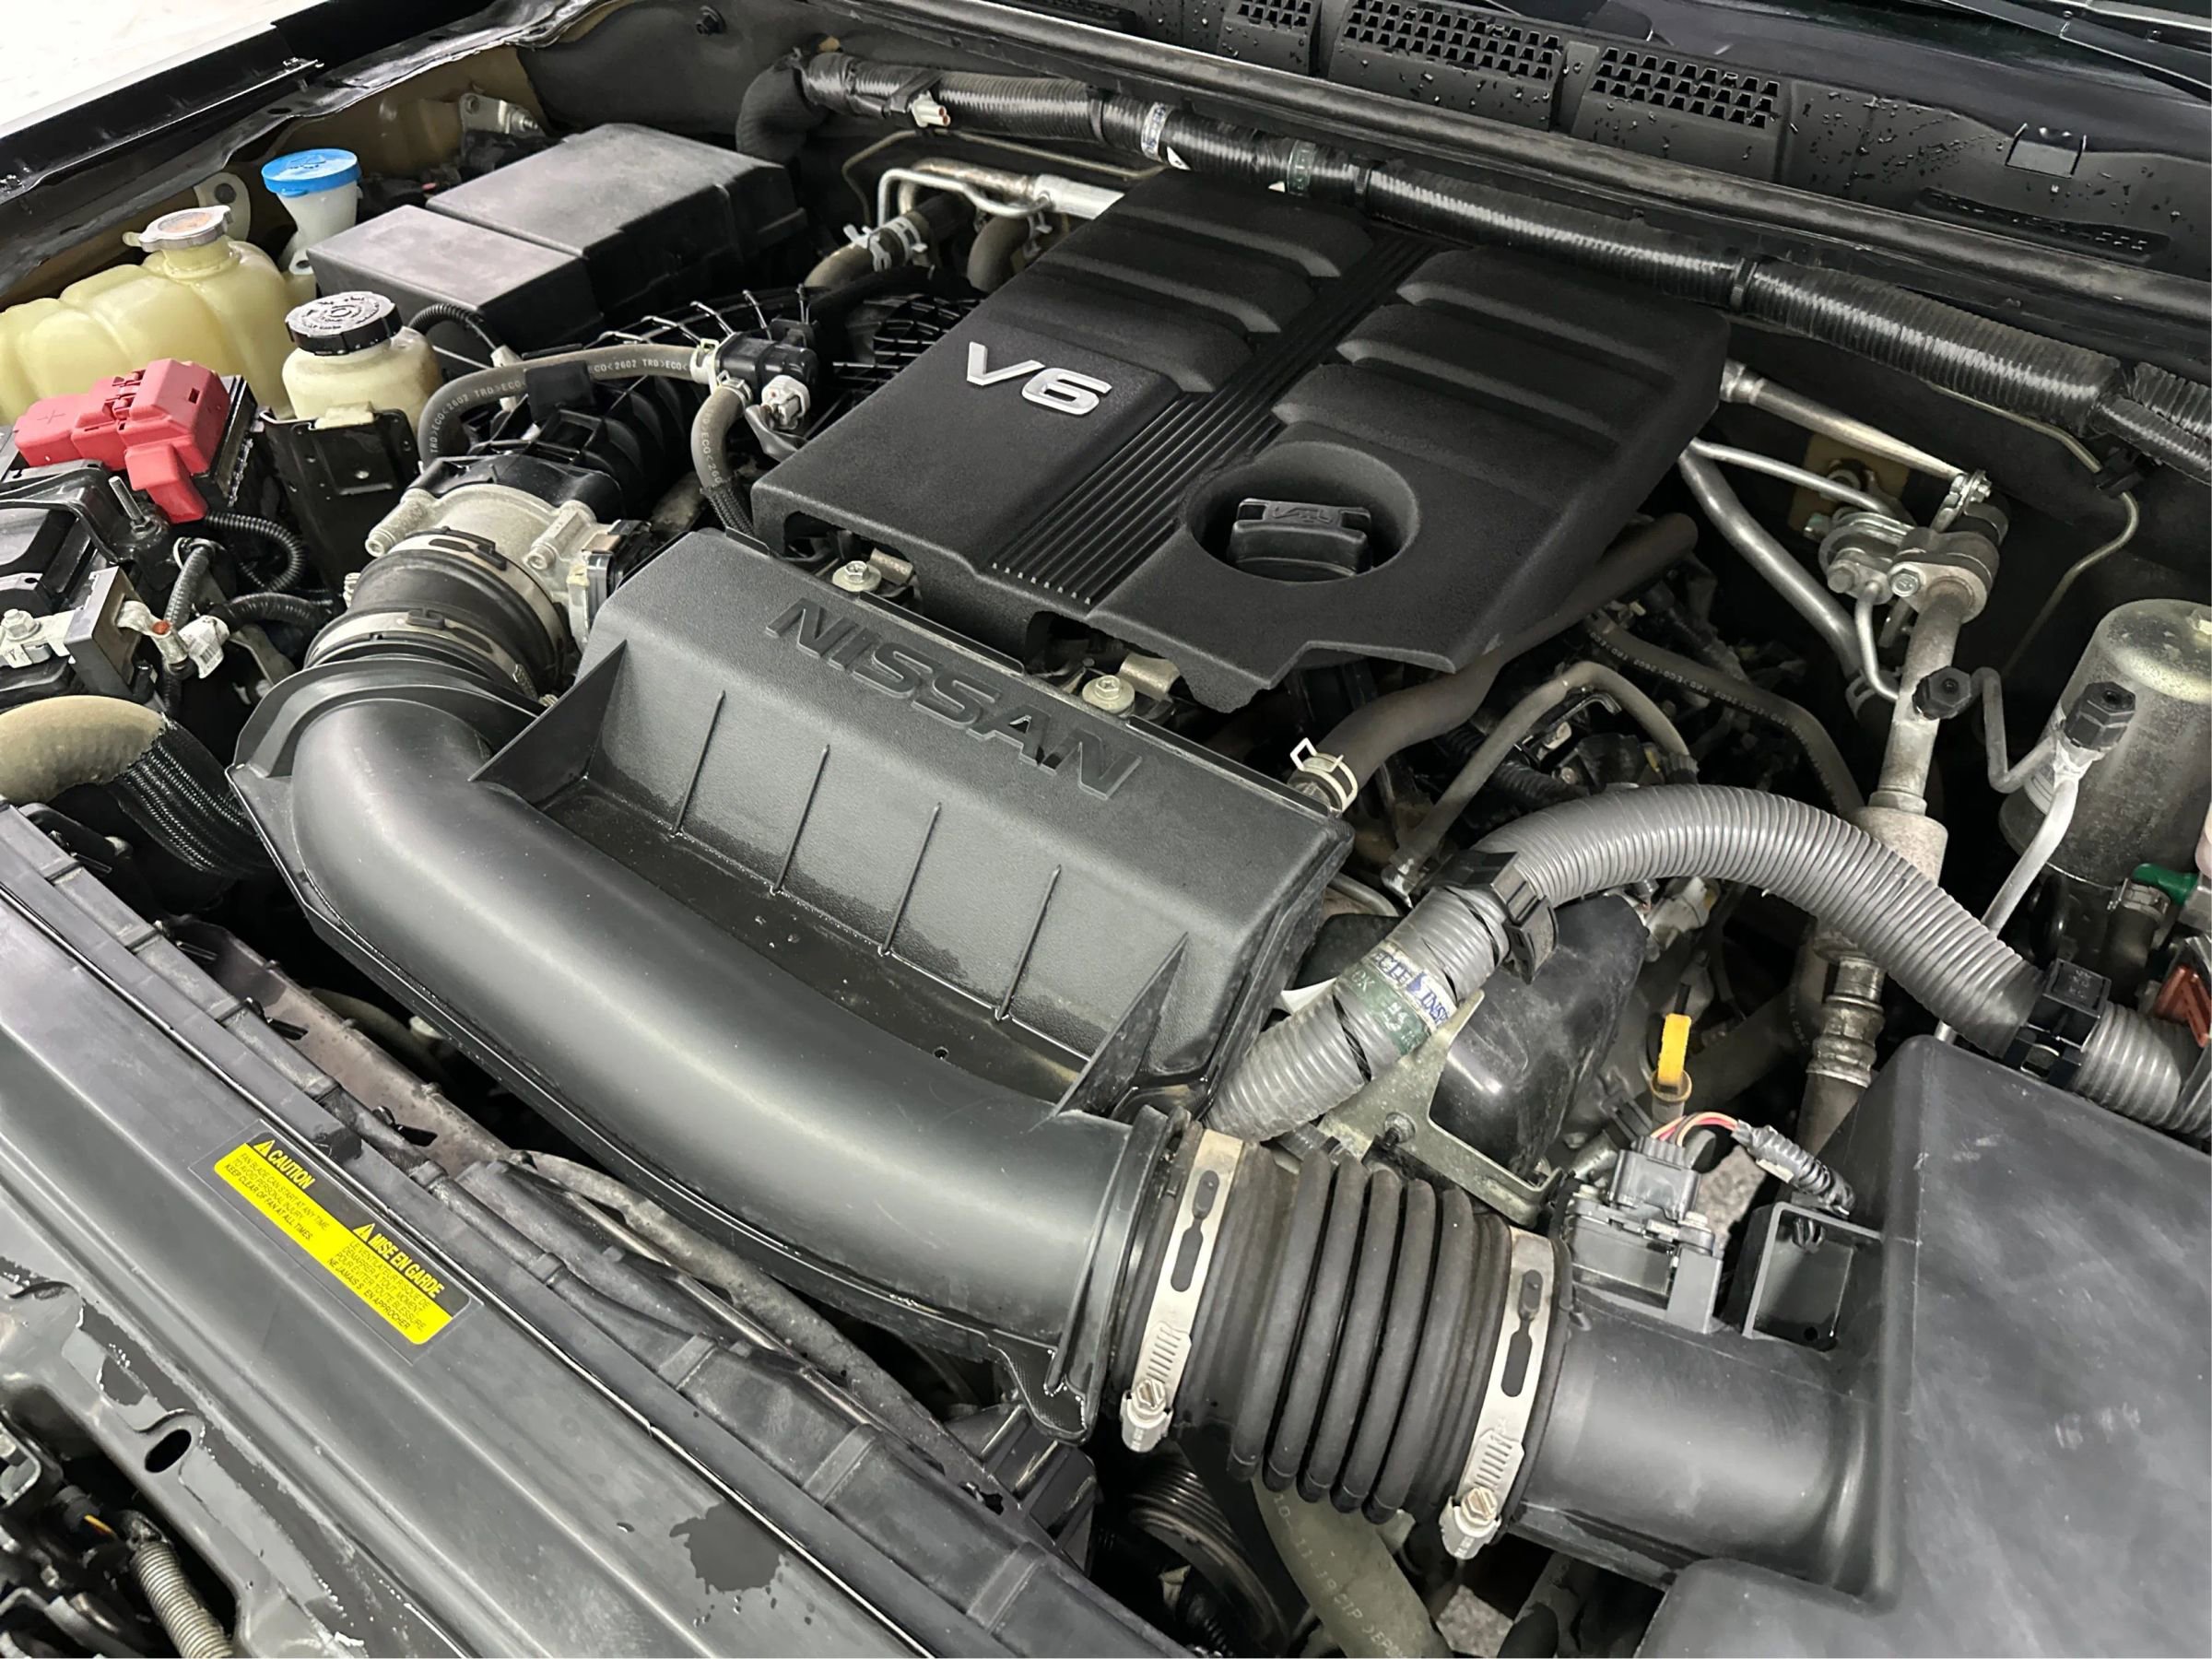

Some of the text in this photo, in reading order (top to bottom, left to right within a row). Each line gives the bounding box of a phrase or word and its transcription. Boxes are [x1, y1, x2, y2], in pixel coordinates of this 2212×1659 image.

[966, 340, 1112, 416] V6
[766, 597, 1142, 801] NISSAN
[225, 1163, 242, 1179] KEEP
[237, 1174, 260, 1194] CLEAR
[255, 1190, 268, 1201] OF
[263, 1196, 279, 1210] FAN
[274, 1206, 287, 1217] AT
[281, 1212, 297, 1225] ALL
[231, 1159, 243, 1168] TO
[239, 1152, 253, 1164] FAN
[249, 1161, 271, 1180] BLADE
[266, 1175, 282, 1189] CAN
[277, 1185, 300, 1204] START
[294, 1199, 306, 1209] AT
[301, 1206, 317, 1218] ANY
[267, 1149, 316, 1189] CAUTION
[326, 1257, 340, 1268] NE
[335, 1265, 359, 1286] JAMAIS
[371, 1296, 411, 1330] APPROCHER
[335, 1252, 355, 1269] POUR
[372, 1284, 395, 1303] TOUTE
[348, 1240, 361, 1251] LE
[418, 1299, 431, 1310] DE
[367, 1232, 444, 1298] MISE EN GARDE
[378, 1277, 398, 1294] TOUT
